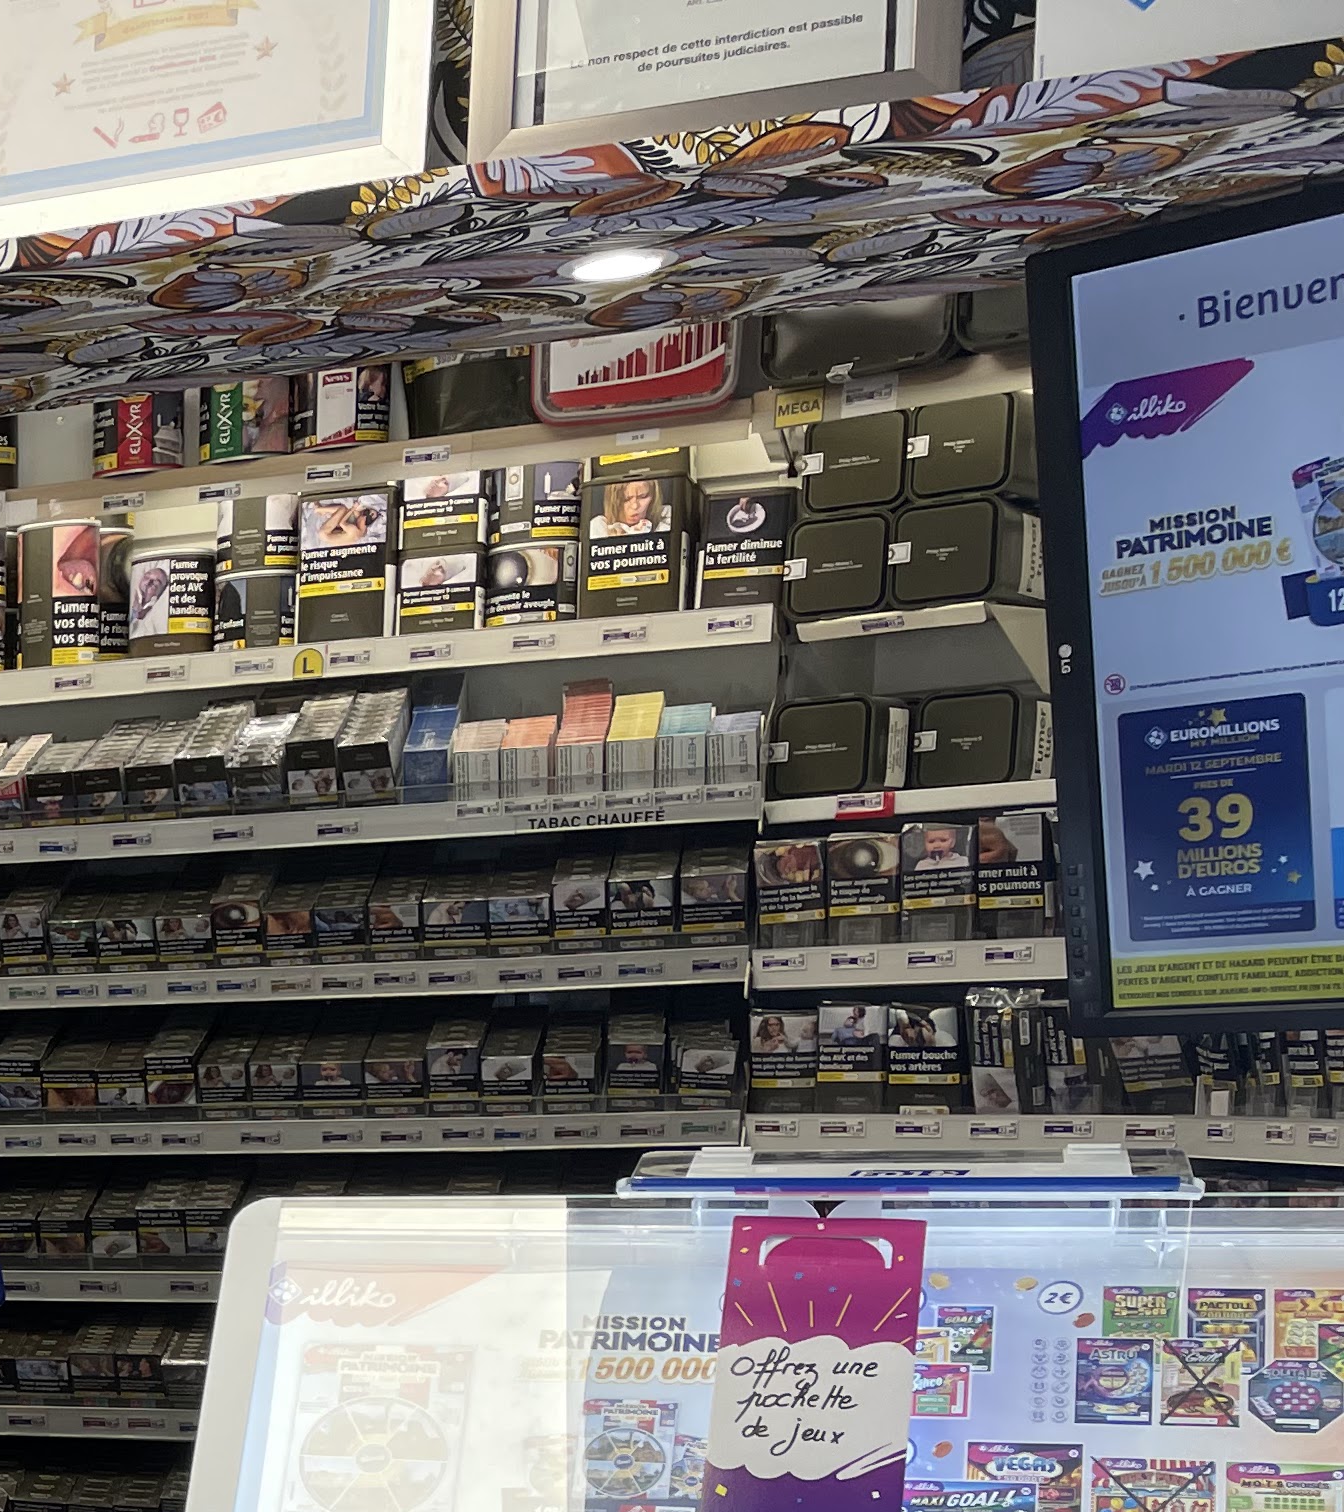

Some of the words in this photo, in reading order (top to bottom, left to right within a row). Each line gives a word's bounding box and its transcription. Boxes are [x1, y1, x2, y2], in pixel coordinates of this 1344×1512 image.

[588, 55, 610, 66] non
[614, 47, 659, 64] respect
[662, 42, 677, 54] de
[681, 39, 711, 51] cette
[715, 25, 785, 46] interdiction
[788, 22, 808, 33] est
[811, 14, 863, 31] passible
[638, 61, 652, 72] de
[656, 51, 720, 71] poursuites
[723, 40, 790, 60] judiciaires.
[777, 397, 821, 416] MEGA
[128, 397, 142, 457] ELIXYR
[1149, 505, 1236, 532] MISSION
[591, 544, 627, 556] Fumer
[630, 542, 654, 553] nuit
[657, 539, 665, 550] à
[706, 542, 738, 553] Fumer
[741, 539, 783, 550] diminue
[1116, 516, 1272, 560] PATRIMOINE
[301, 563, 308, 571] le
[310, 560, 338, 570] risque
[591, 559, 610, 570] vos
[614, 553, 667, 569] poumons
[706, 555, 714, 565] la
[717, 552, 756, 564] fertilité
[1167, 551, 1216, 582] 500
[1222, 544, 1271, 574] 000
[301, 569, 363, 582] d'impuissance
[1060, 658, 1071, 675] LG
[1170, 718, 1280, 742] EUROMILLIONS
[528, 815, 582, 831] TABAC
[586, 808, 666, 826] CHAUFFÉ
[1177, 793, 1254, 843] 39
[1177, 843, 1263, 864] MILLIONS
[1177, 859, 1262, 880] D'EUROS
[1187, 883, 1197, 896] À
[1199, 882, 1252, 896] GAGNER
[583, 1315, 686, 1332] MISSION
[730, 1346, 819, 1390] Offrez
[832, 1361, 878, 1377] une
[735, 1379, 858, 1423] pochette
[742, 1416, 769, 1438] de
[770, 1418, 845, 1456] jeux
